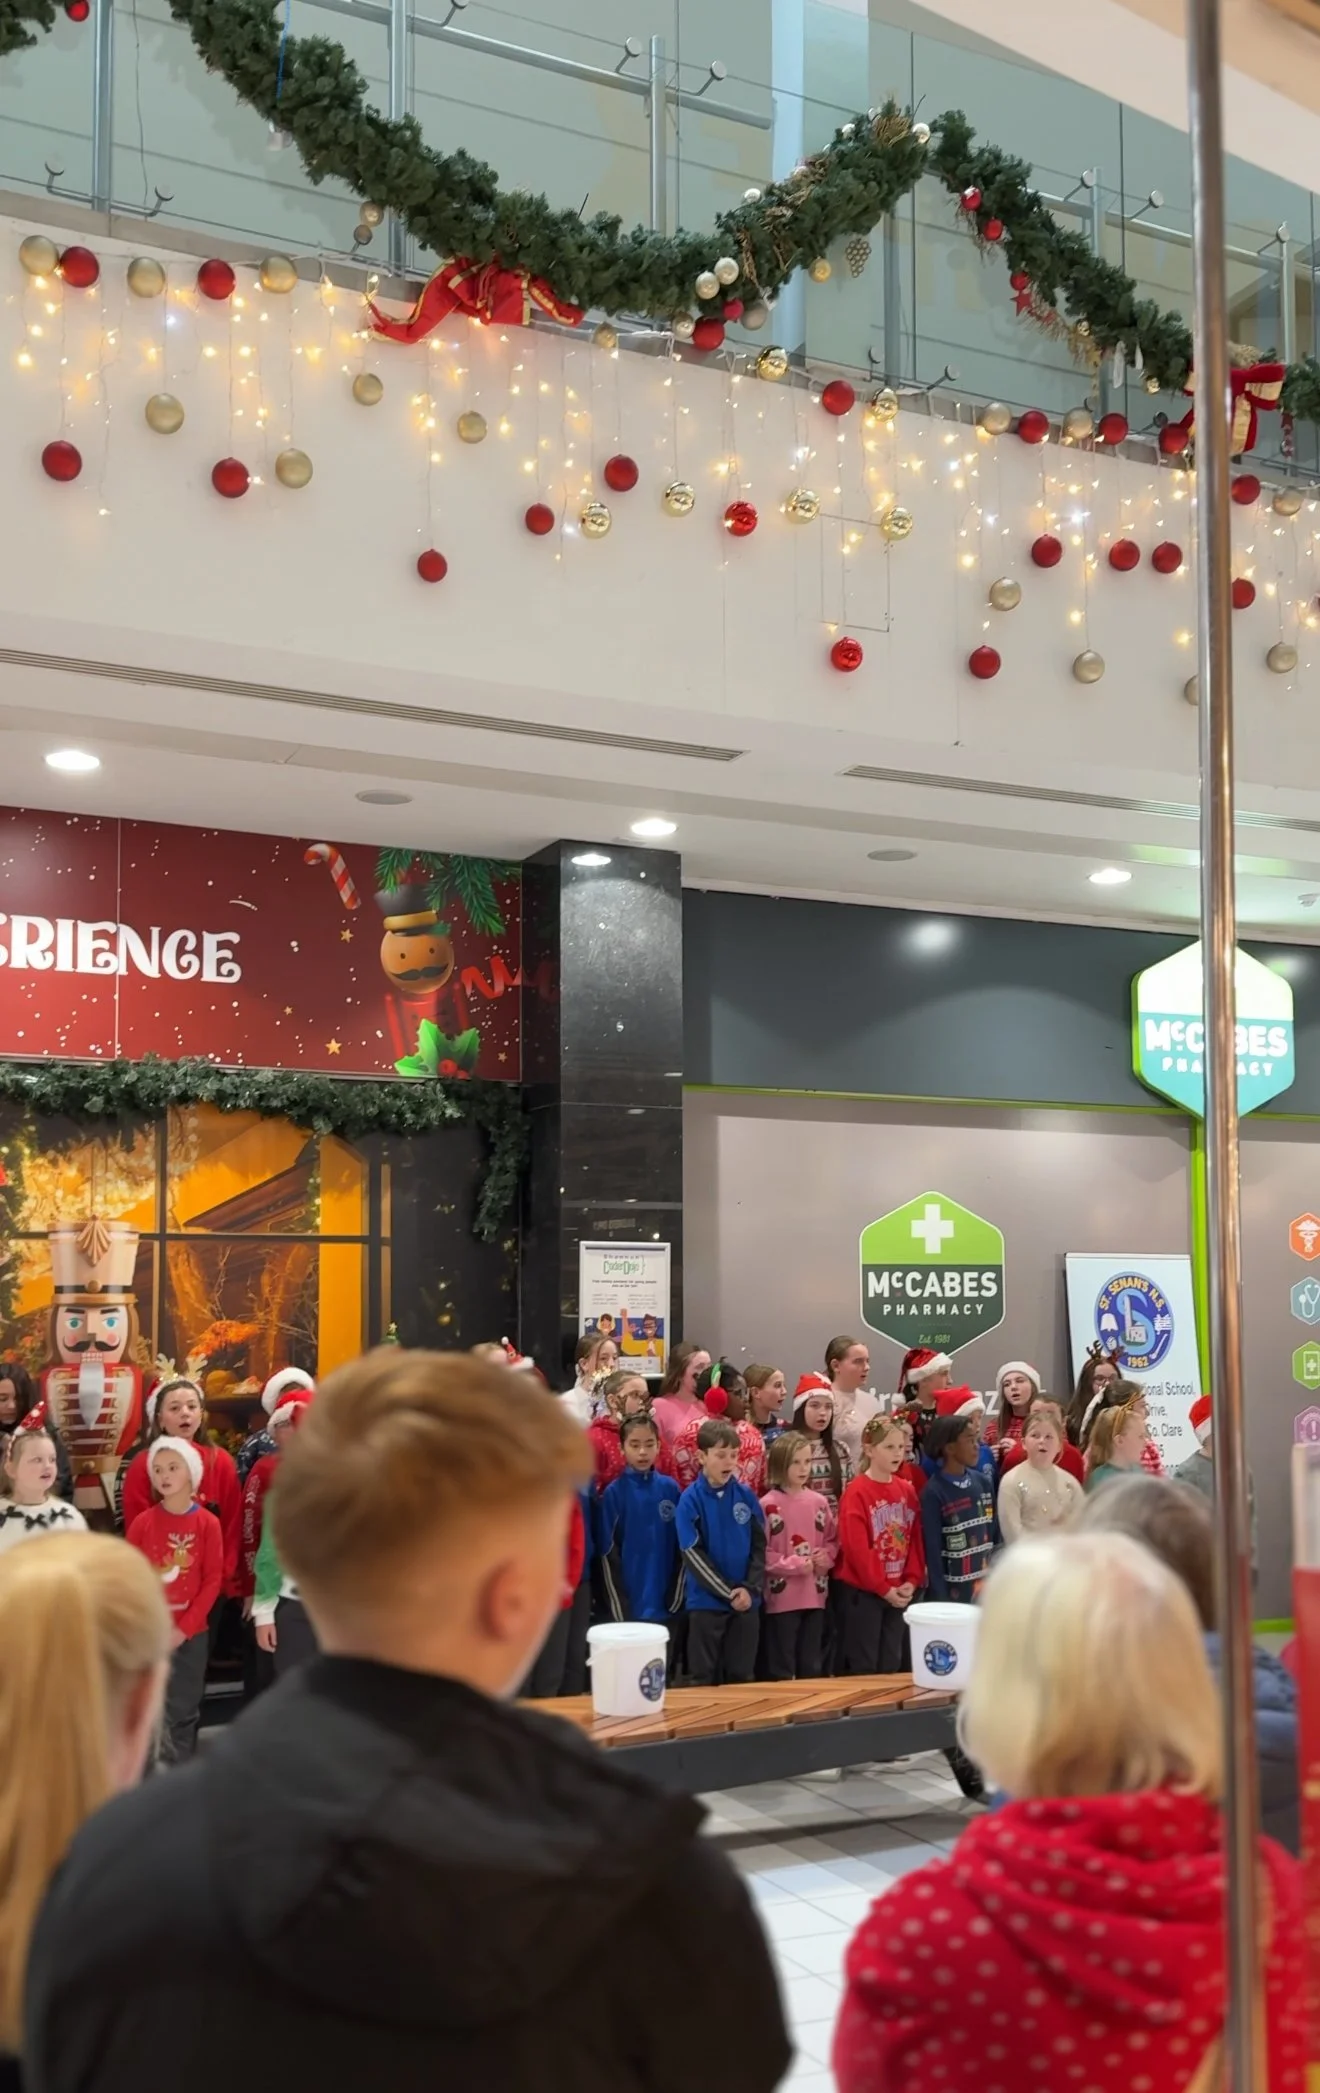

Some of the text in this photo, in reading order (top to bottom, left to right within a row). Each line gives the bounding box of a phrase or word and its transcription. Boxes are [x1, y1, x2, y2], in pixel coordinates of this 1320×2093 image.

[0, 912, 241, 984] RIENCE
[1144, 1018, 1288, 1058] McCBES
[1162, 1057, 1273, 1076] PHAACY
[883, 1303, 984, 1316] PHARMACY
[1127, 1355, 1149, 1368] 1962
[1161, 1423, 1183, 1437] Clare
